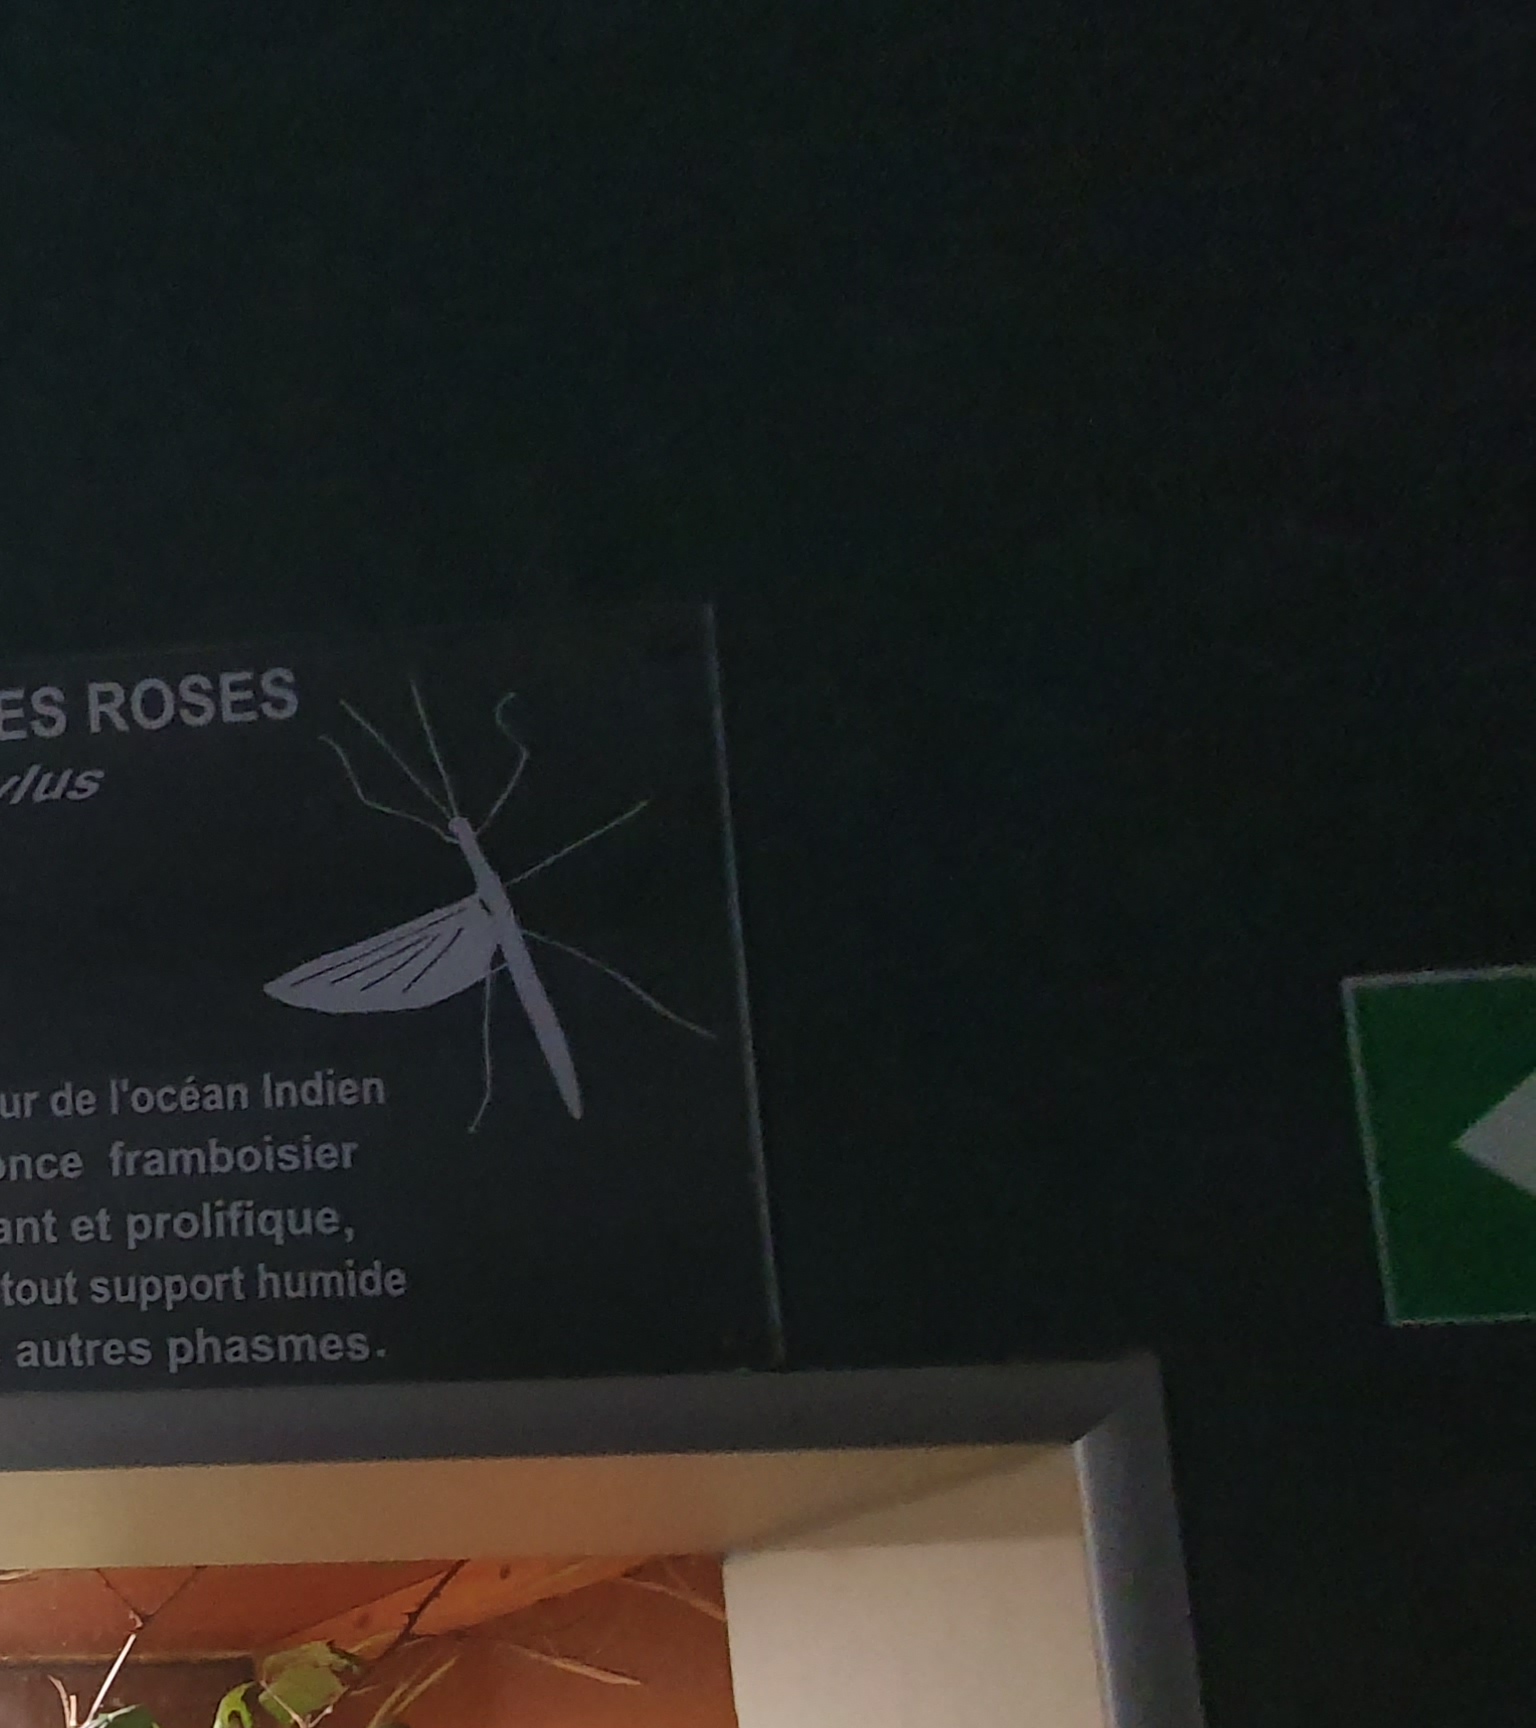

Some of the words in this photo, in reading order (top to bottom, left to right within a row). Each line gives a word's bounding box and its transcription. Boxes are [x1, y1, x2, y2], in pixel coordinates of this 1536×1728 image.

[87, 666, 300, 733] ROSES
[50, 1085, 97, 1120] de
[109, 1076, 248, 1117] l'océan
[262, 1069, 386, 1109] Indien
[108, 1134, 358, 1177] framboisier
[69, 1206, 113, 1242] et
[125, 1199, 355, 1248] prolifique,
[0, 1268, 79, 1305] tout
[90, 1265, 244, 1308] support
[256, 1260, 408, 1299] humide
[16, 1330, 153, 1368] autres
[167, 1324, 387, 1371] phasmes.
